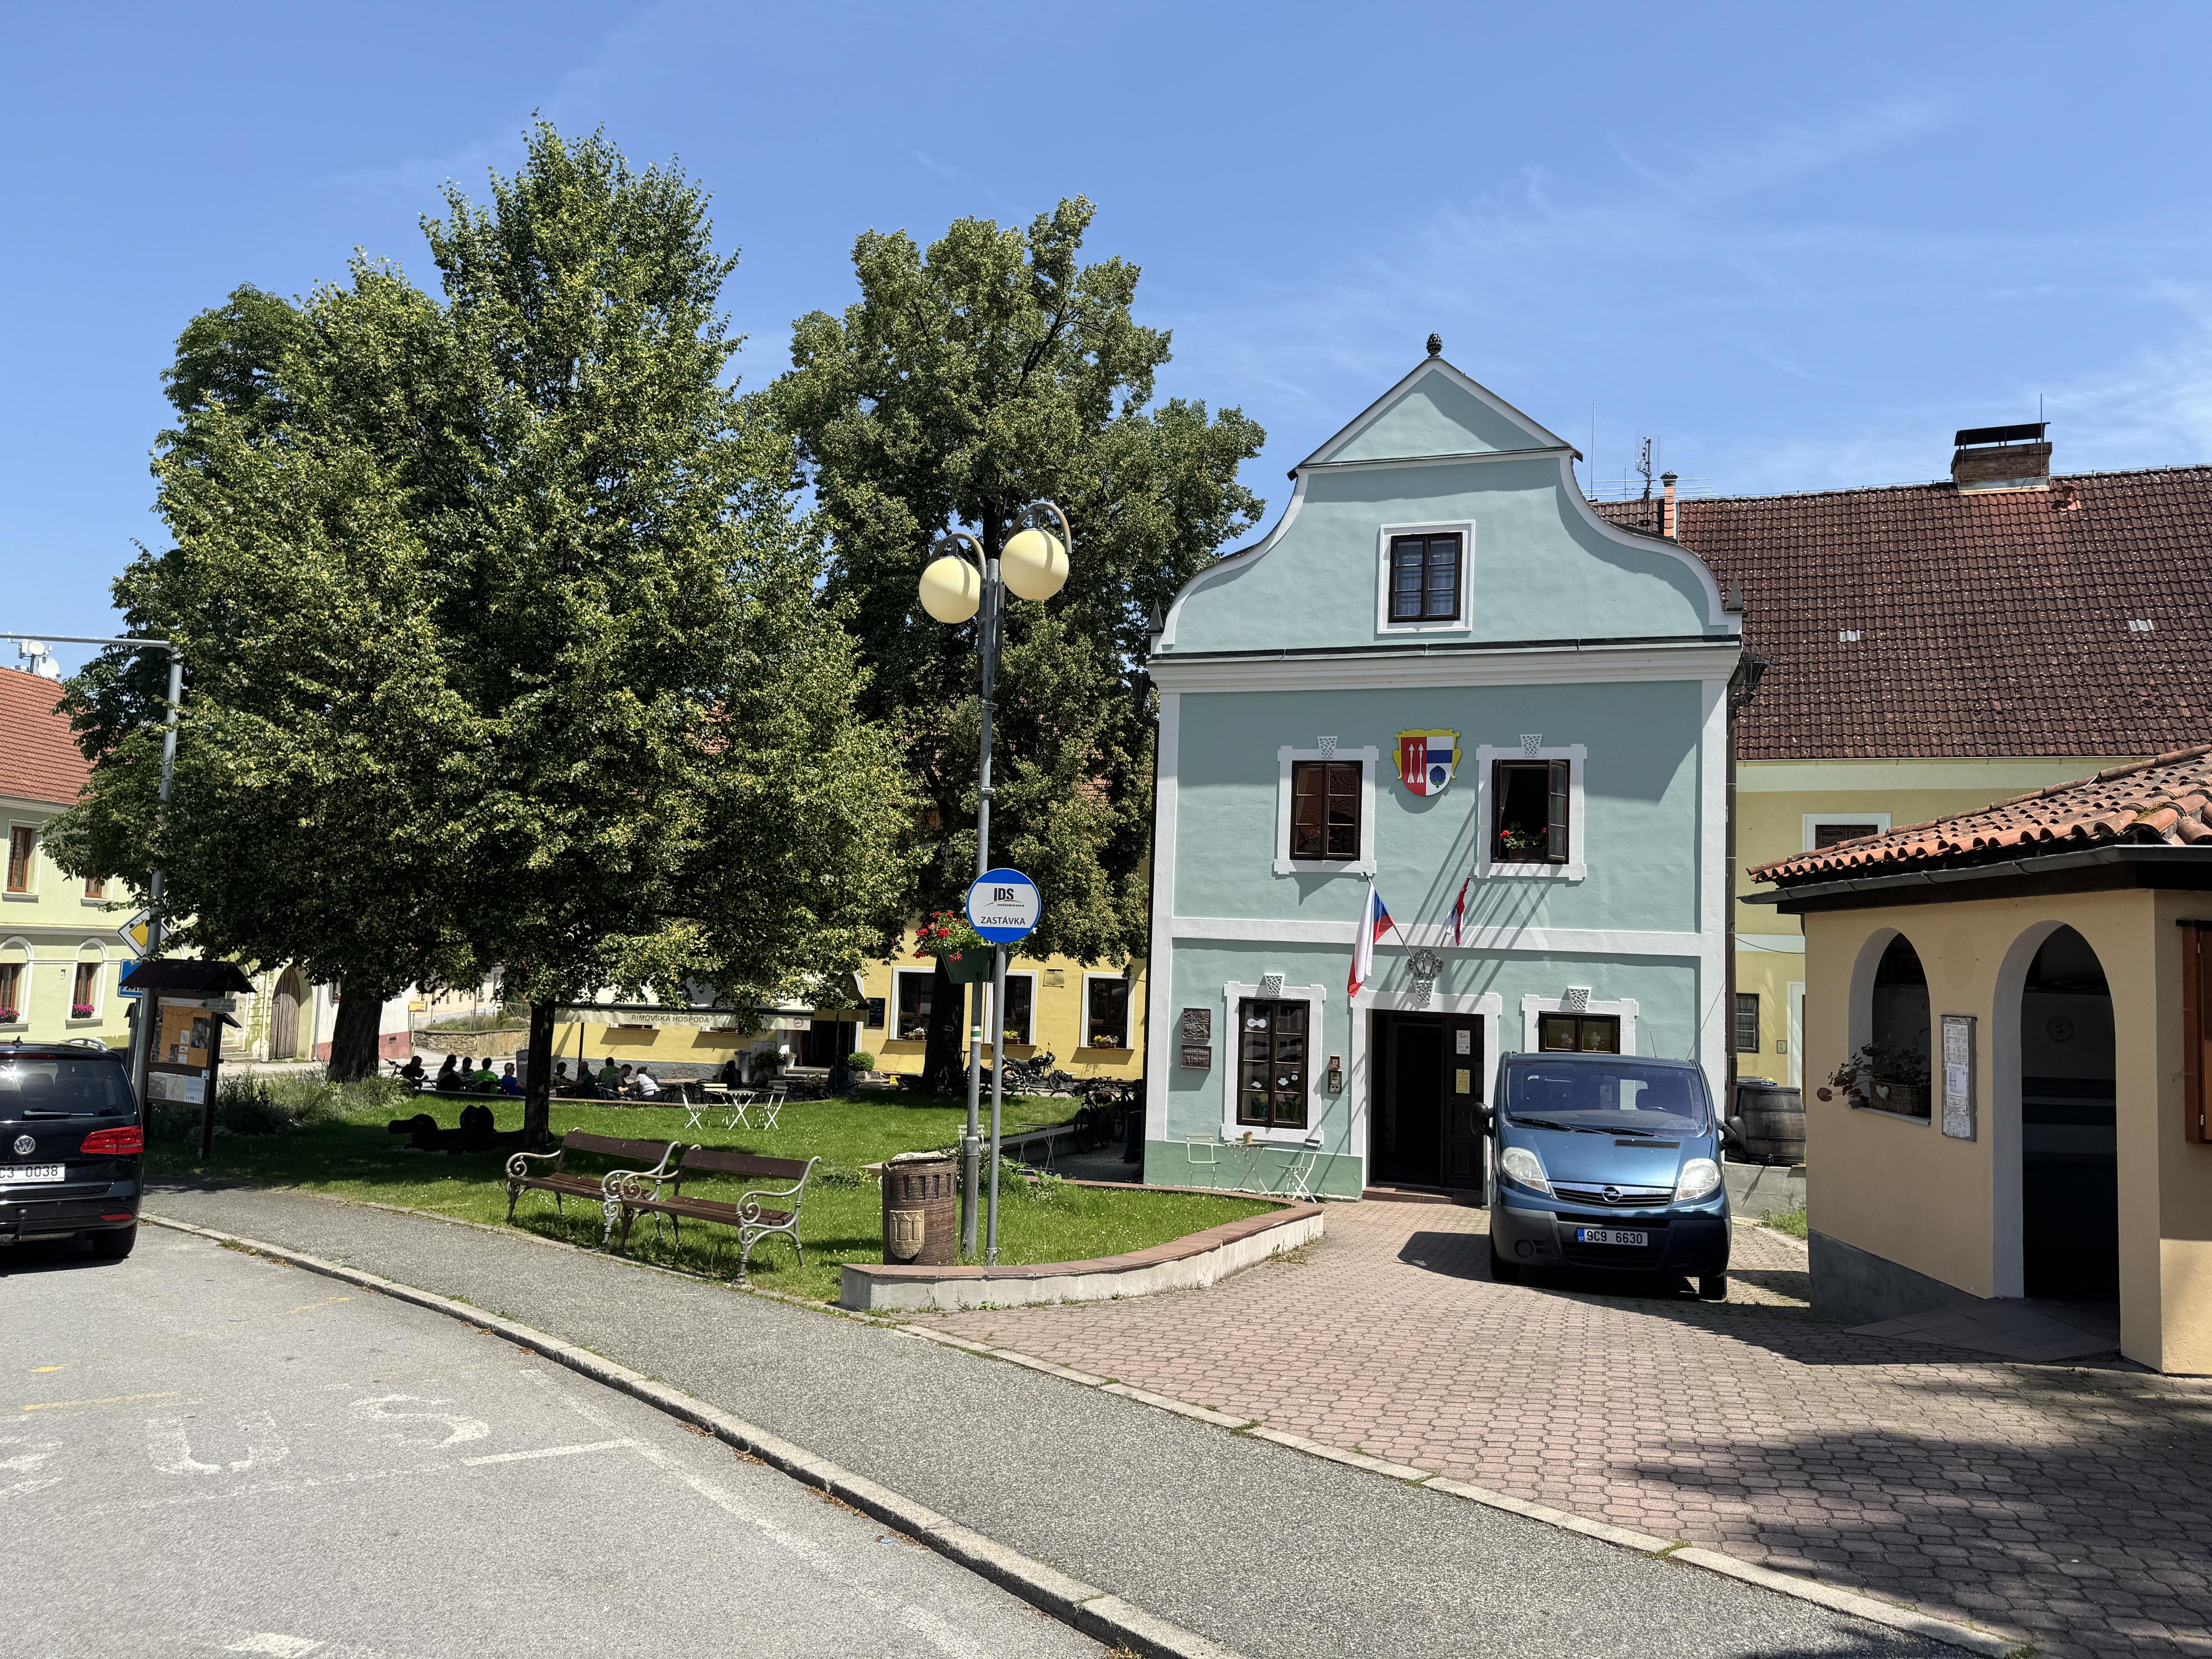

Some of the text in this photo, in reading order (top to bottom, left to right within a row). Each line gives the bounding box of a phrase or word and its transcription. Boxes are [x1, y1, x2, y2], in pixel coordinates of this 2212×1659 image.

[994, 888, 1014, 901] IDS
[981, 916, 1025, 925] ZASTÁVKA
[26, 1165, 58, 1177] 0038
[1587, 1230, 1607, 1241] 9C9
[1616, 1232, 1642, 1244] 6630
